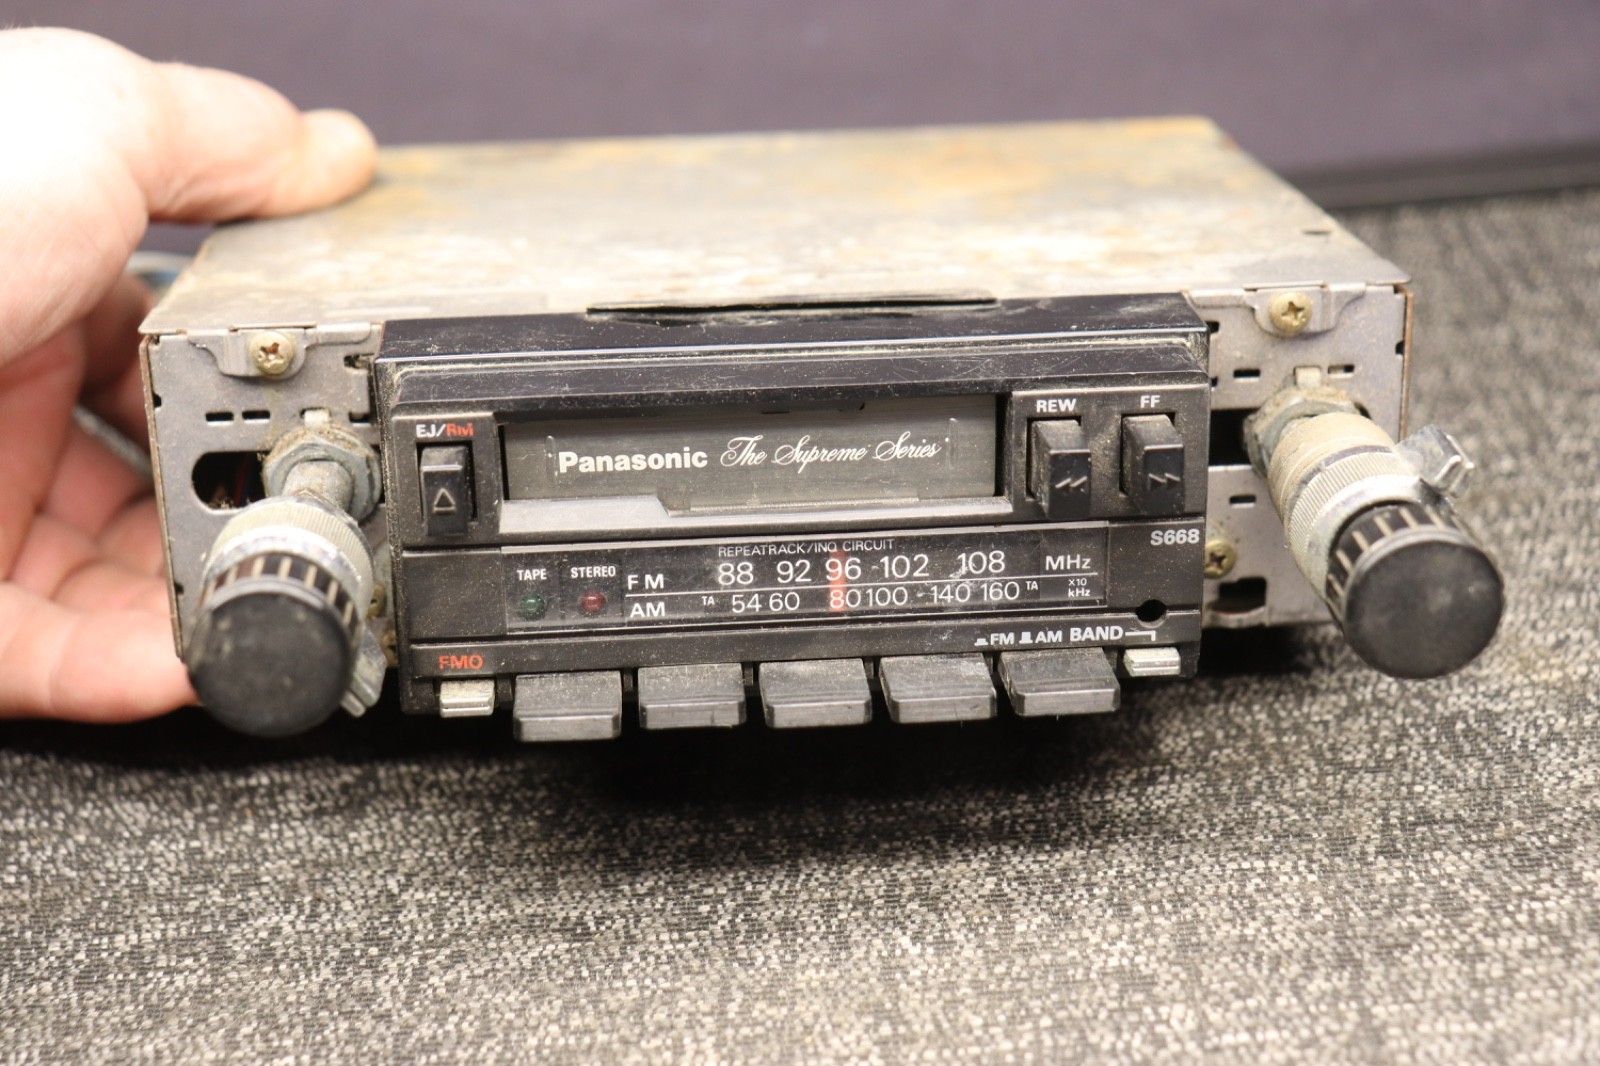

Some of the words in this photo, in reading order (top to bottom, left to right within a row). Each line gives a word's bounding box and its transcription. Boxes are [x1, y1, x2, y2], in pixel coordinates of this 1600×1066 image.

[1036, 398, 1077, 414] REW
[1140, 395, 1161, 409] FF
[416, 422, 475, 438] EJ/RM
[558, 446, 708, 474] Panasonic
[720, 435, 767, 467] The
[772, 435, 868, 473] Supreme
[872, 431, 941, 460] Series
[842, 539, 895, 552] CIRCUIT
[1151, 529, 1200, 546] S668
[517, 569, 547, 581] TAPE
[571, 566, 616, 579] STEREO
[627, 574, 664, 590] FM
[718, 561, 754, 586] 88
[776, 559, 812, 583] 92
[825, 557, 862, 581] 96
[880, 554, 930, 578] 102
[957, 550, 1005, 574] 108
[1045, 554, 1091, 570] MHz
[630, 602, 665, 618] AM
[702, 595, 715, 606] TA
[732, 593, 762, 613] 54
[769, 592, 800, 611] 60
[830, 589, 861, 609] 80
[866, 587, 908, 607] 100
[931, 584, 971, 604] 140
[981, 581, 1020, 601] 160
[1026, 581, 1038, 591] TA
[1068, 588, 1091, 598] kHz
[990, 632, 1015, 646] FM
[1035, 630, 1063, 643] AM
[1070, 626, 1124, 642] BAND
